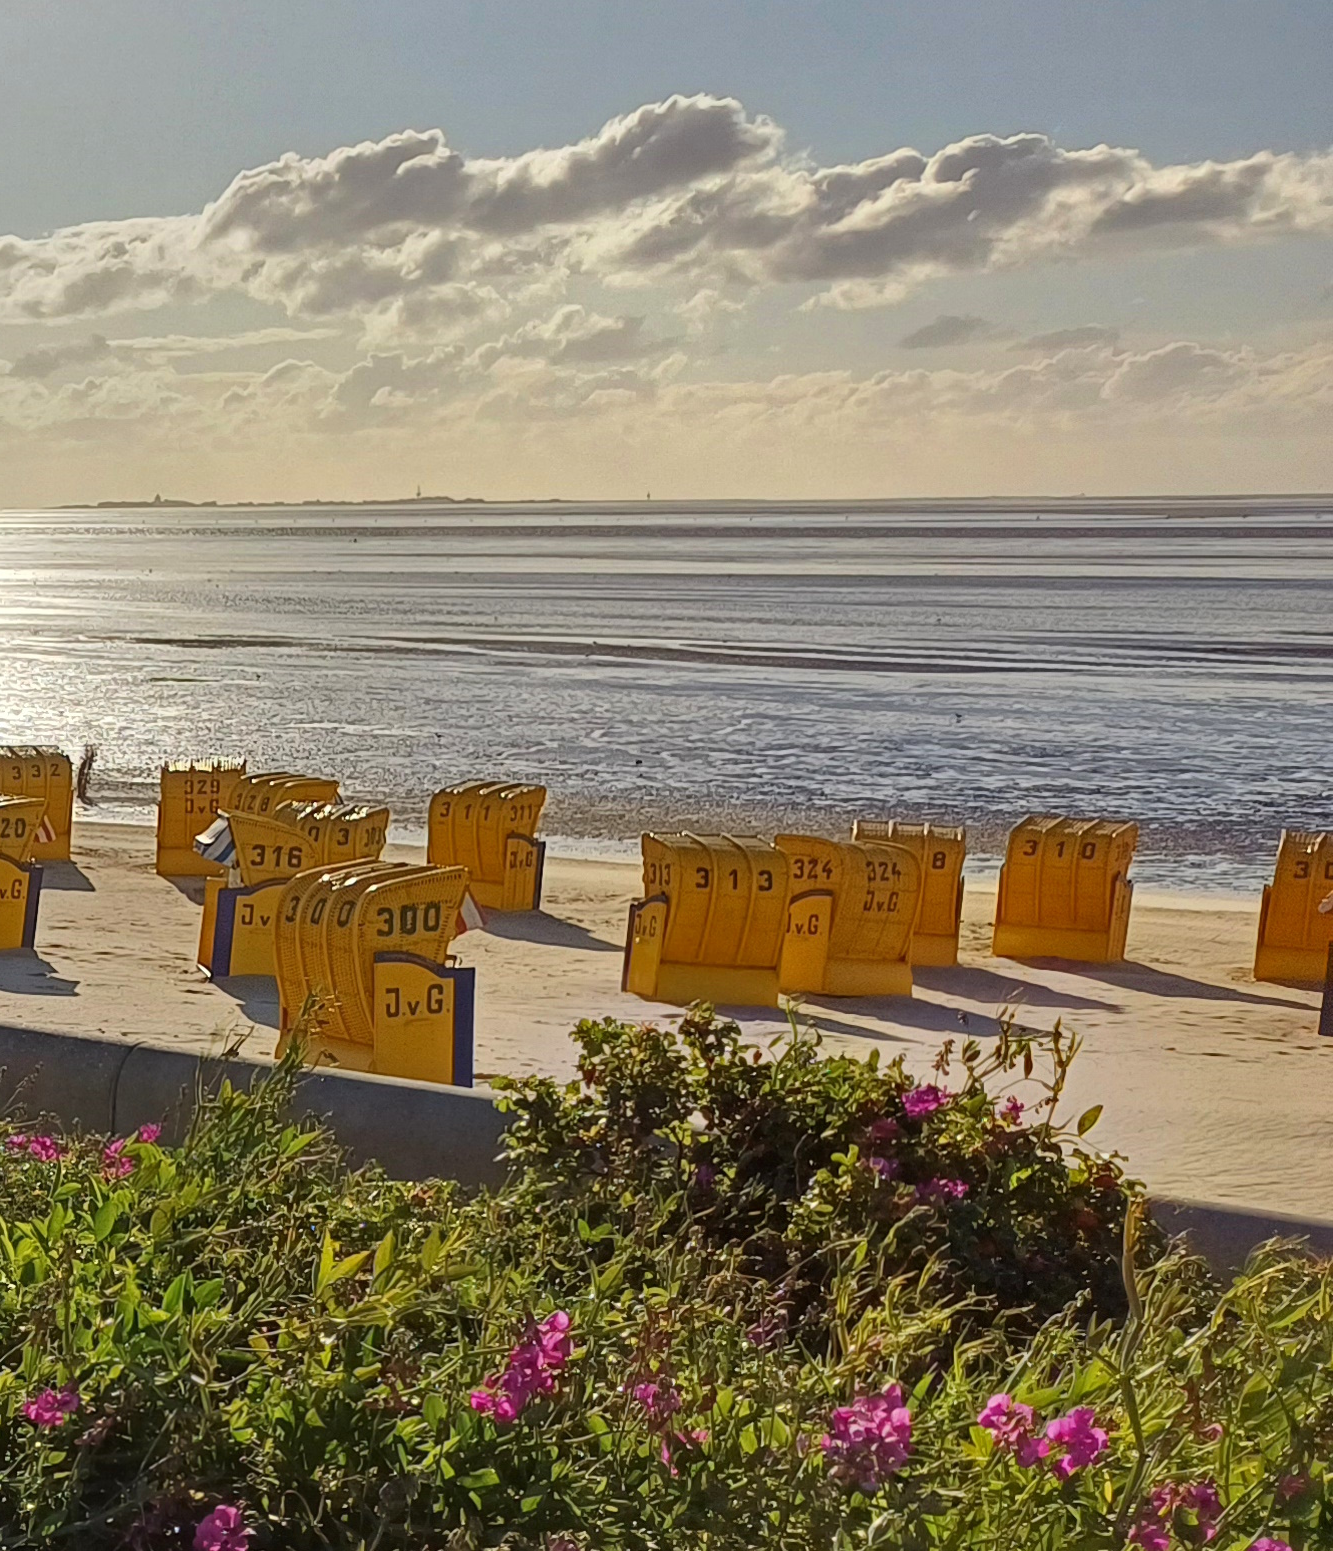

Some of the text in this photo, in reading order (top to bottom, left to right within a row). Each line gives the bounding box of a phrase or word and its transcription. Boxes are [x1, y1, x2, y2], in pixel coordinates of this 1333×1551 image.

[184, 779, 221, 795] 329
[250, 844, 303, 868] 316
[650, 863, 671, 886] 313
[793, 858, 833, 880] 324
[865, 861, 902, 882] 324
[376, 903, 441, 937] 300
